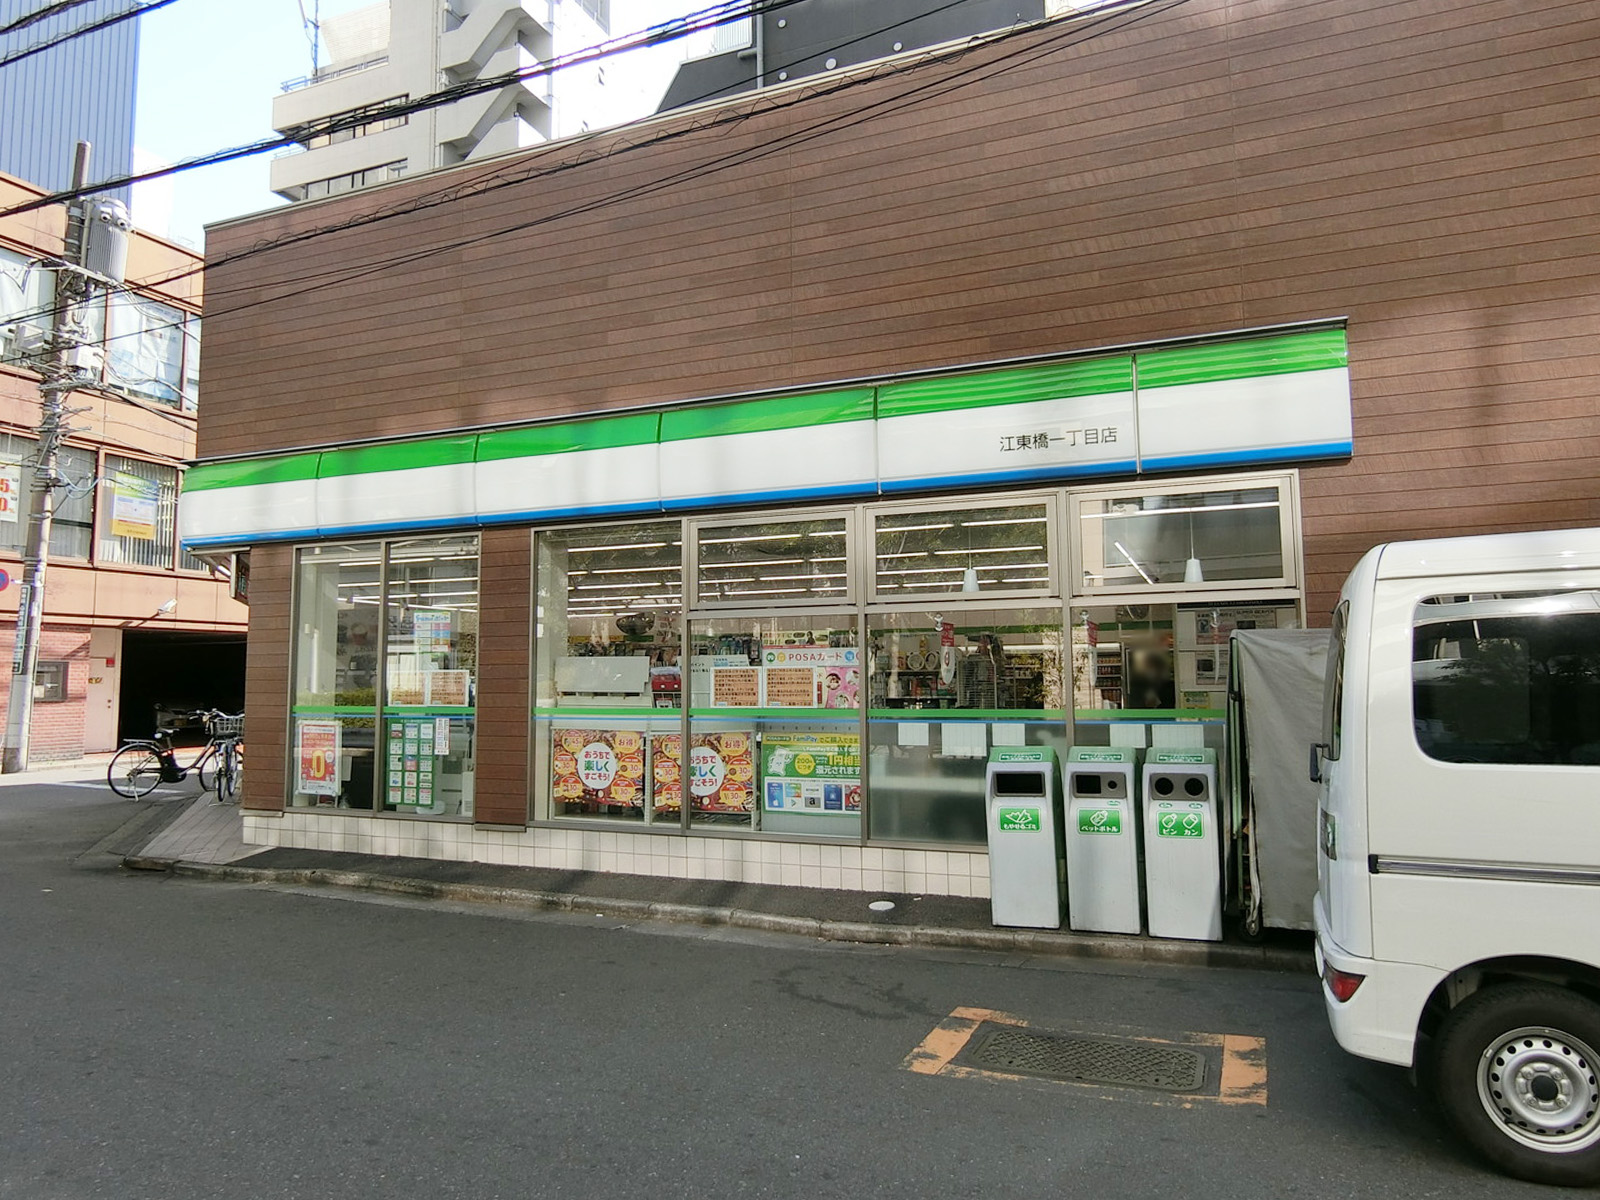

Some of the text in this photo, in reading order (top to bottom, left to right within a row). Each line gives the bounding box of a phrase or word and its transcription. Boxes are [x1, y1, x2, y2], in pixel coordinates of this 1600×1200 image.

[999, 426, 1118, 452] 江東橋一丁目店
[788, 652, 843, 662] POSAカード
[584, 751, 611, 760] おうちで
[584, 760, 610, 772] 楽しく
[584, 772, 611, 782] すごそう!
[1081, 825, 1119, 833] ペットボトル
